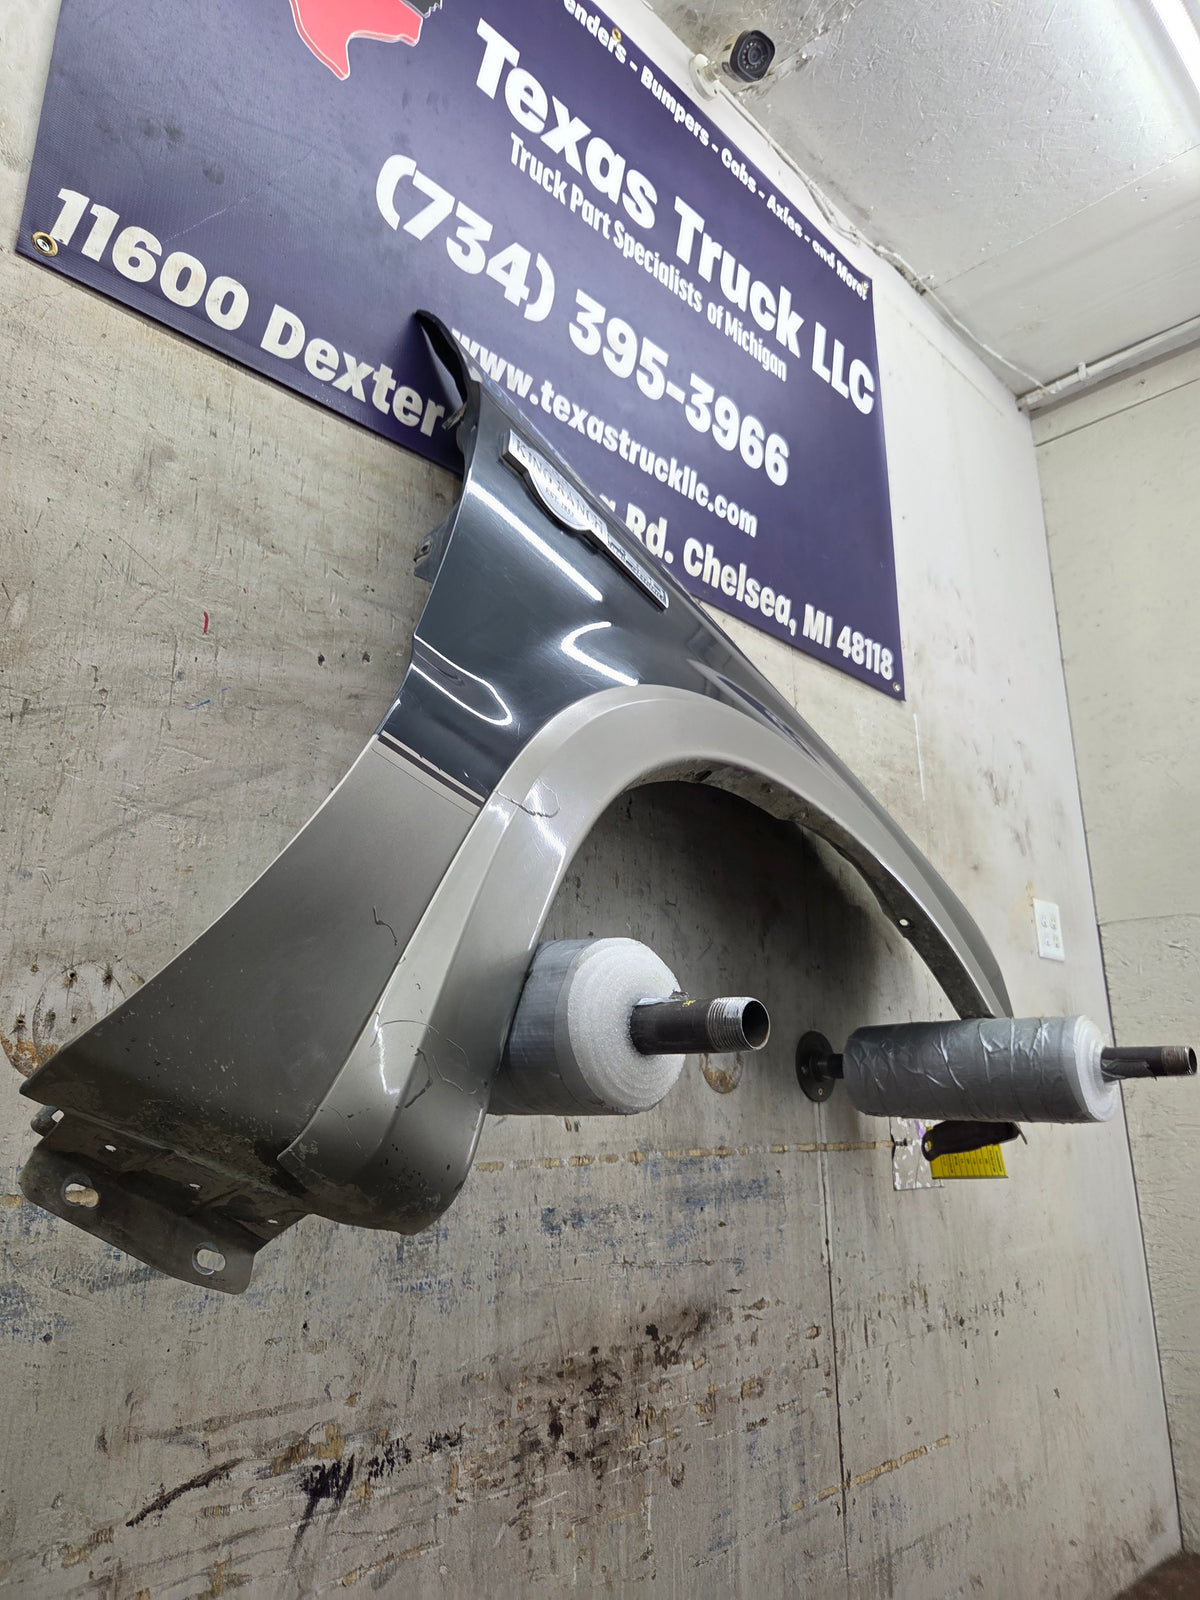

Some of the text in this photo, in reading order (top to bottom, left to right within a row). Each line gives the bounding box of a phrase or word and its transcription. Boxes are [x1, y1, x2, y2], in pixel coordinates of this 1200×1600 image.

[476, 17, 876, 415] Texas Truck LLC
[510, 131, 788, 382] Truck Part Specialists of Michigan
[629, 60, 638, 72] -
[641, 65, 710, 147] Bumpers
[711, 143, 719, 153] -
[721, 147, 757, 194] Cabs
[758, 190, 766, 199] -
[766, 194, 803, 238] Axles
[804, 235, 811, 243] -
[812, 240, 836, 269] and
[49, 188, 250, 331] 11600
[260, 303, 446, 437] Dexter
[625, 502, 674, 564] Rd.
[683, 537, 798, 636] Chelsea,
[802, 603, 834, 649] MI
[836, 625, 894, 681] 48118
[375, 154, 790, 486] (734) 395-3966
[451, 327, 758, 538] www.texastruckllc.com
[515, 438, 604, 535] KING RANCH
